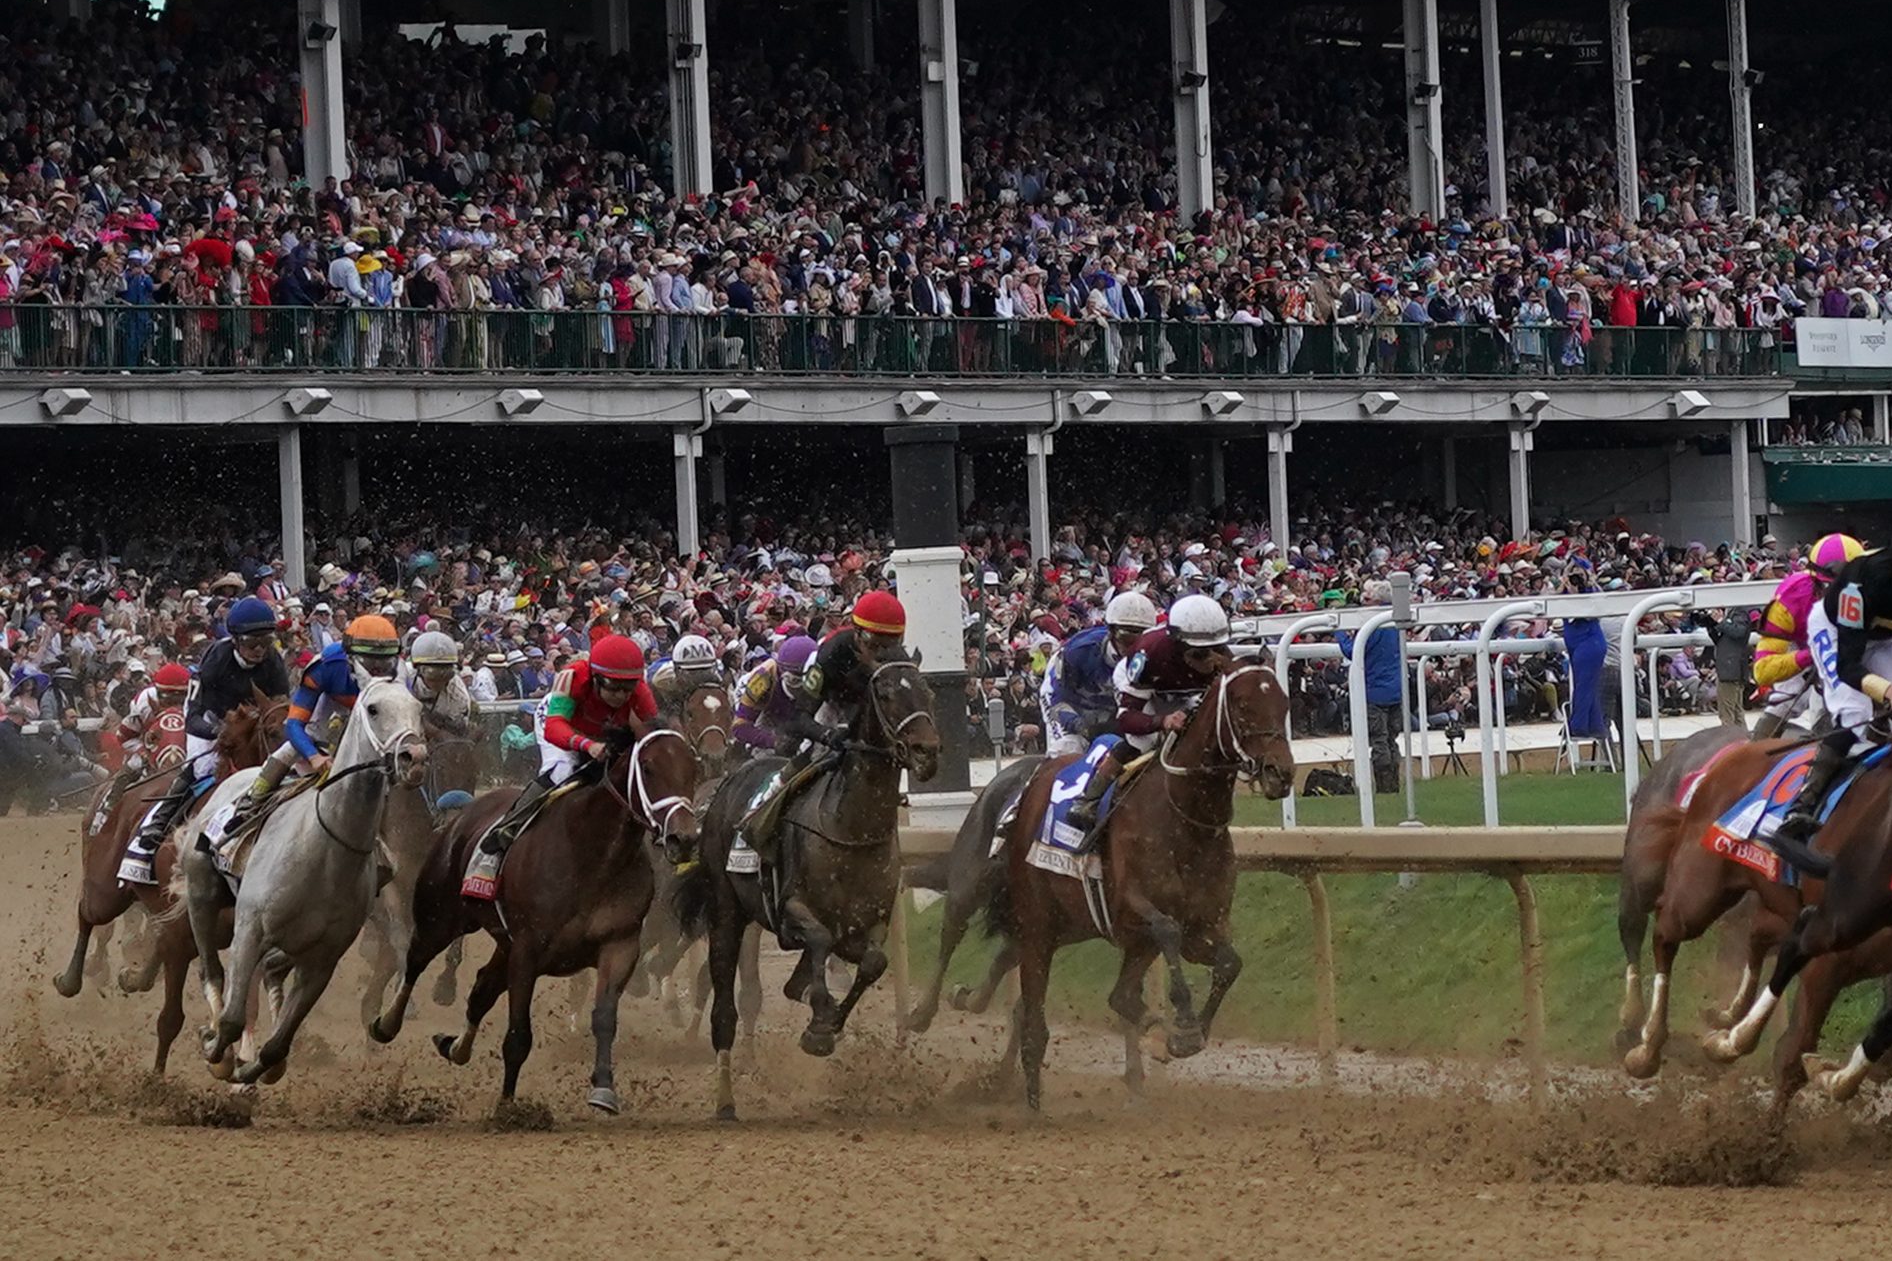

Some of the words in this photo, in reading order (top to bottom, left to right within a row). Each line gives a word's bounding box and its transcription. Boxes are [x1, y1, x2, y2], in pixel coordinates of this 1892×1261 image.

[1577, 46, 1598, 58] 318
[1840, 593, 1861, 622] 16
[807, 669, 821, 688] 5
